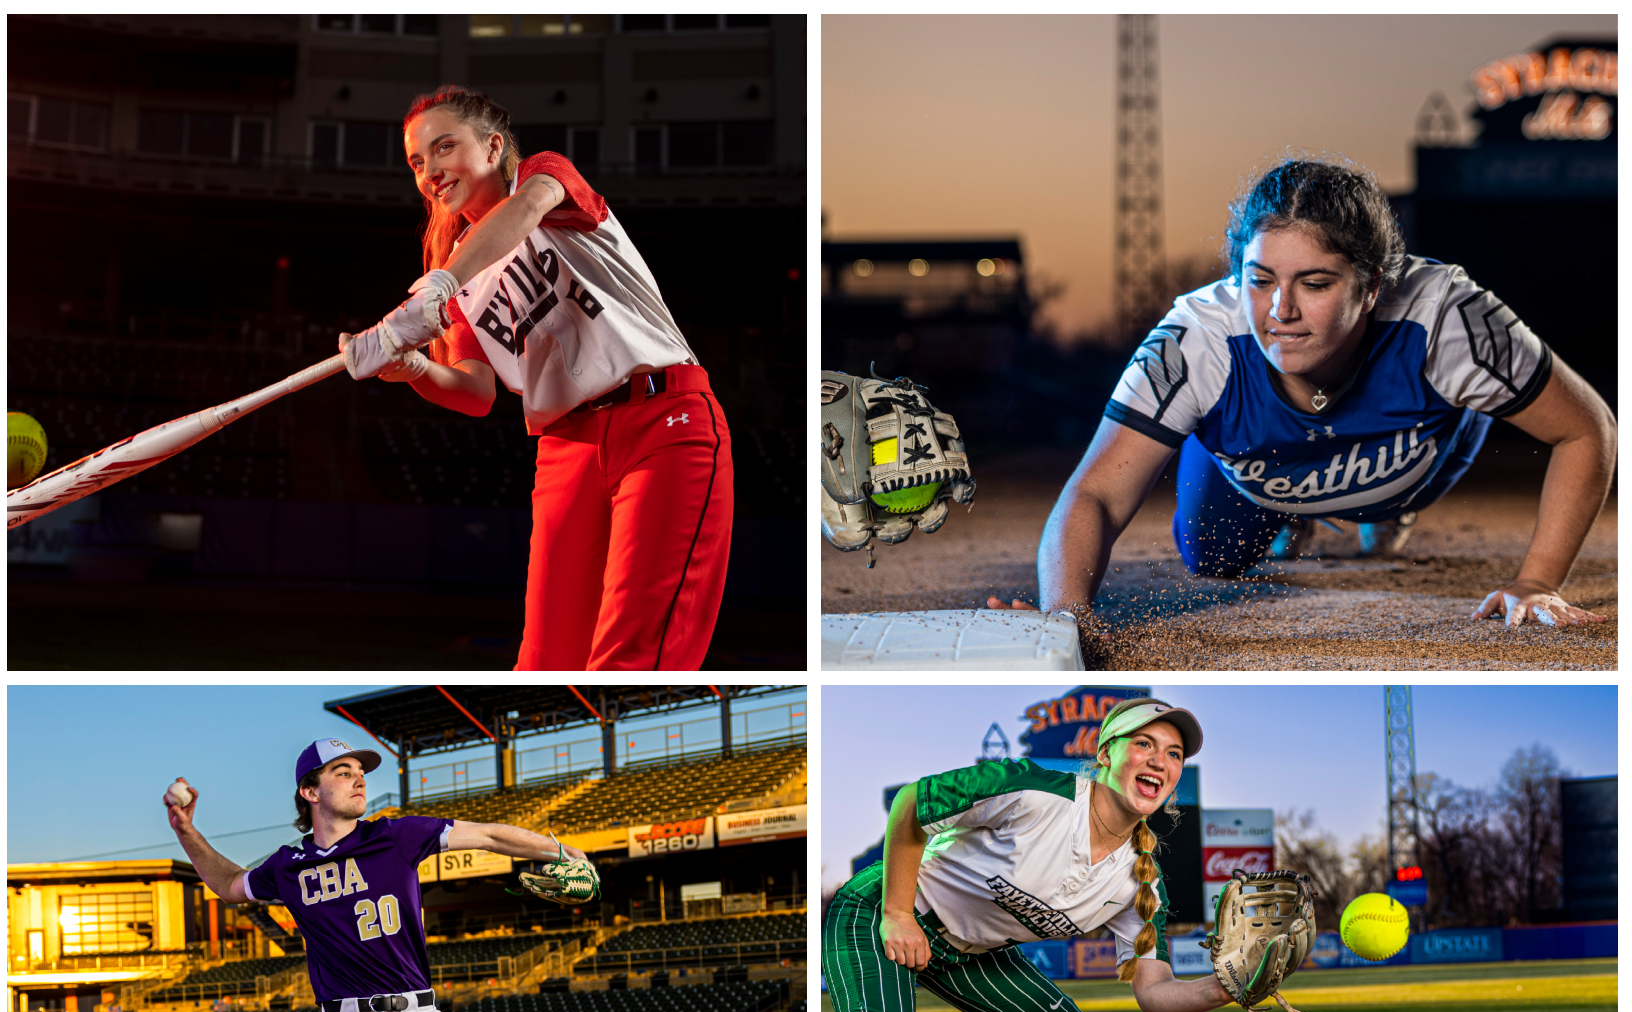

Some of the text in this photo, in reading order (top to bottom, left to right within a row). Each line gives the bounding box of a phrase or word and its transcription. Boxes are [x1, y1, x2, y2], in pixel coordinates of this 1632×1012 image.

[565, 278, 605, 321] 6
[1026, 693, 1126, 734] SYRAC
[641, 834, 700, 855] 1260
[650, 818, 707, 840] SCORE
[297, 856, 369, 906] CBA
[353, 894, 402, 942] 20
[1222, 959, 1243, 992] Wilson
